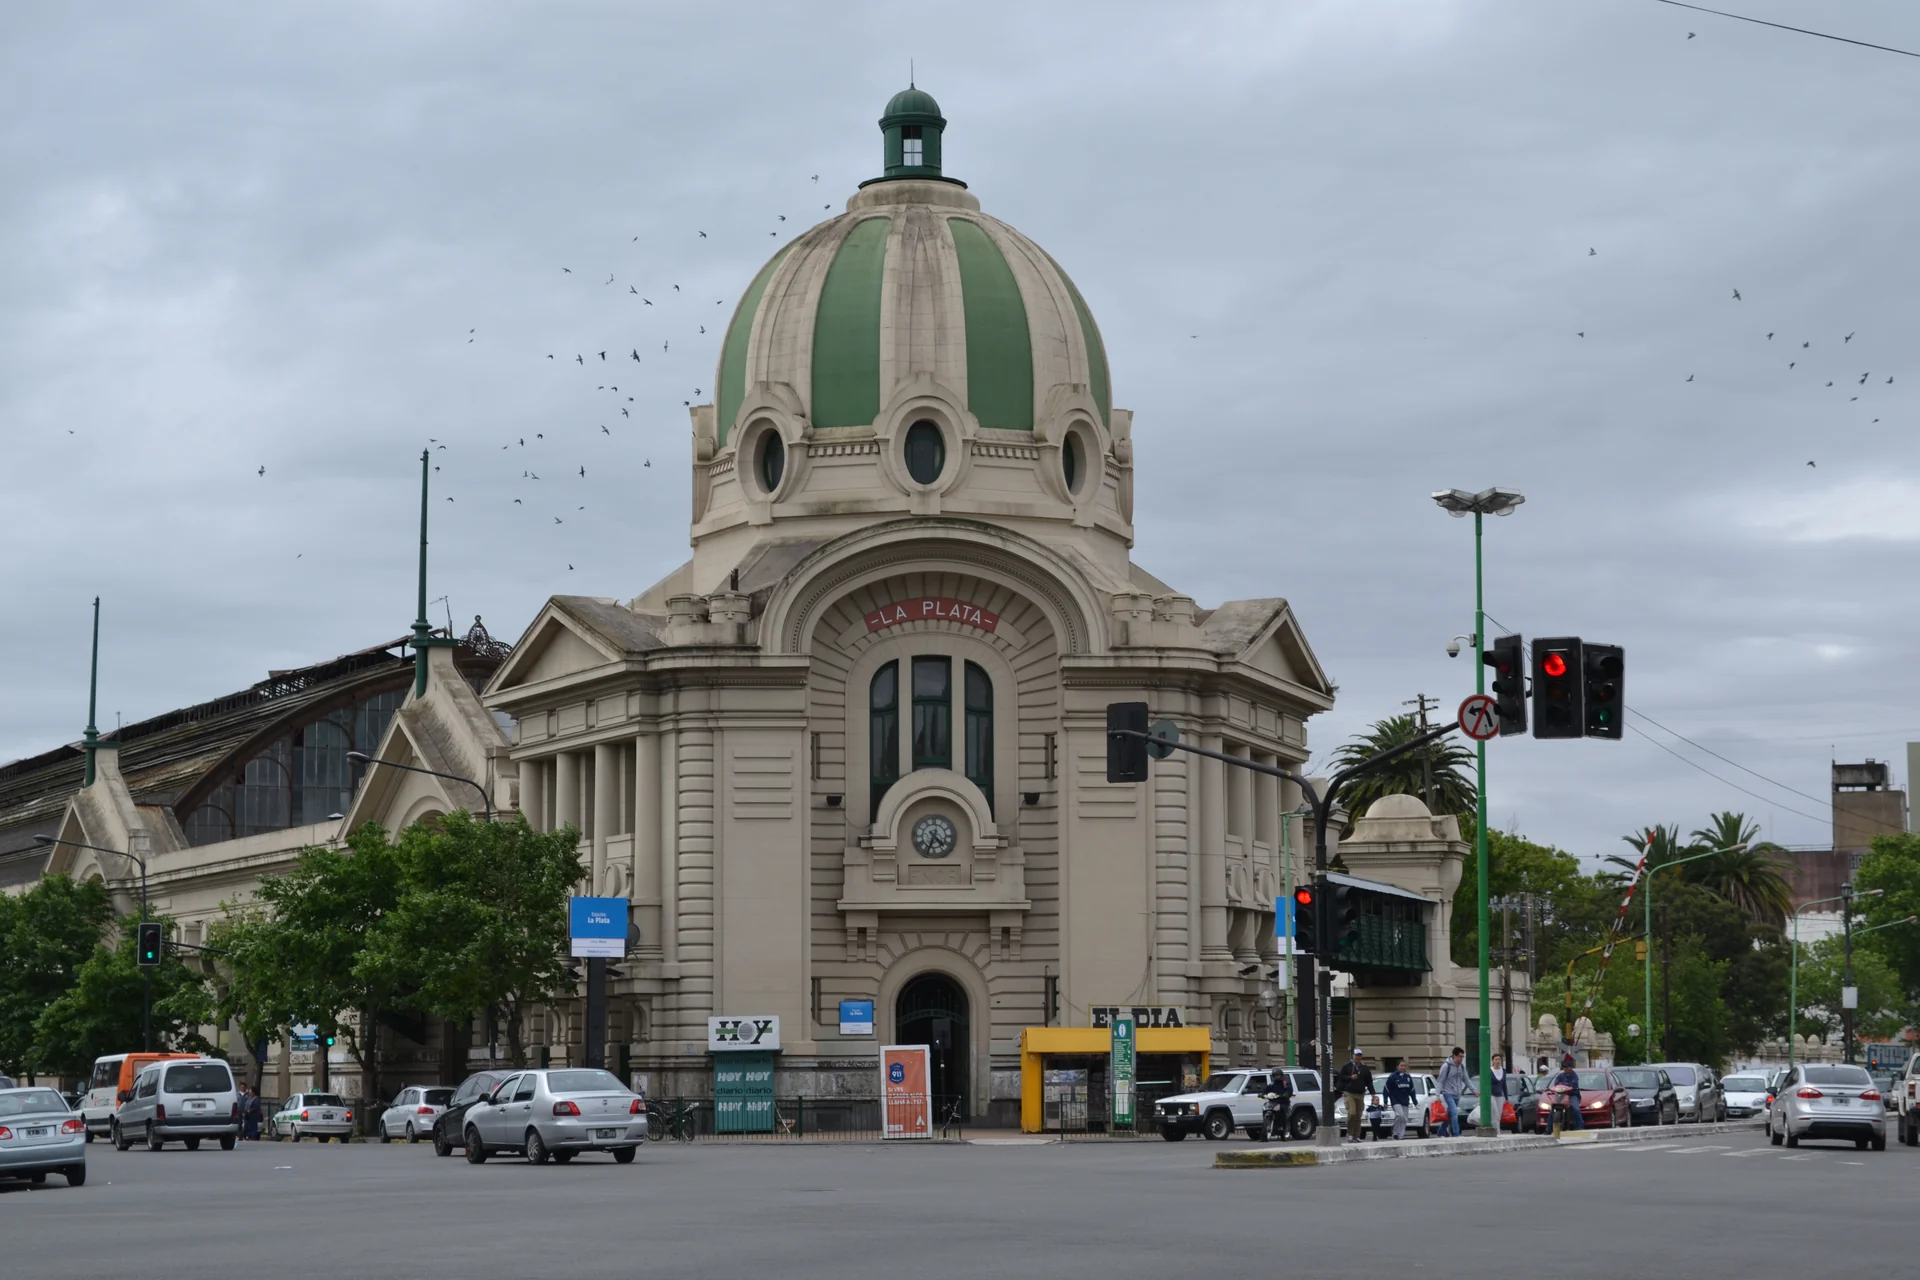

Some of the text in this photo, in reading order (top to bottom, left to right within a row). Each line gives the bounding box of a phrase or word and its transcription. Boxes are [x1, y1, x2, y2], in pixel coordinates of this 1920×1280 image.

[1132, 1008, 1183, 1028] DIA
[717, 1021, 772, 1044] HOY
[718, 1071, 771, 1082] HOY HOY
[717, 1086, 772, 1095] diario diario
[718, 1102, 771, 1112] HOY HOY
